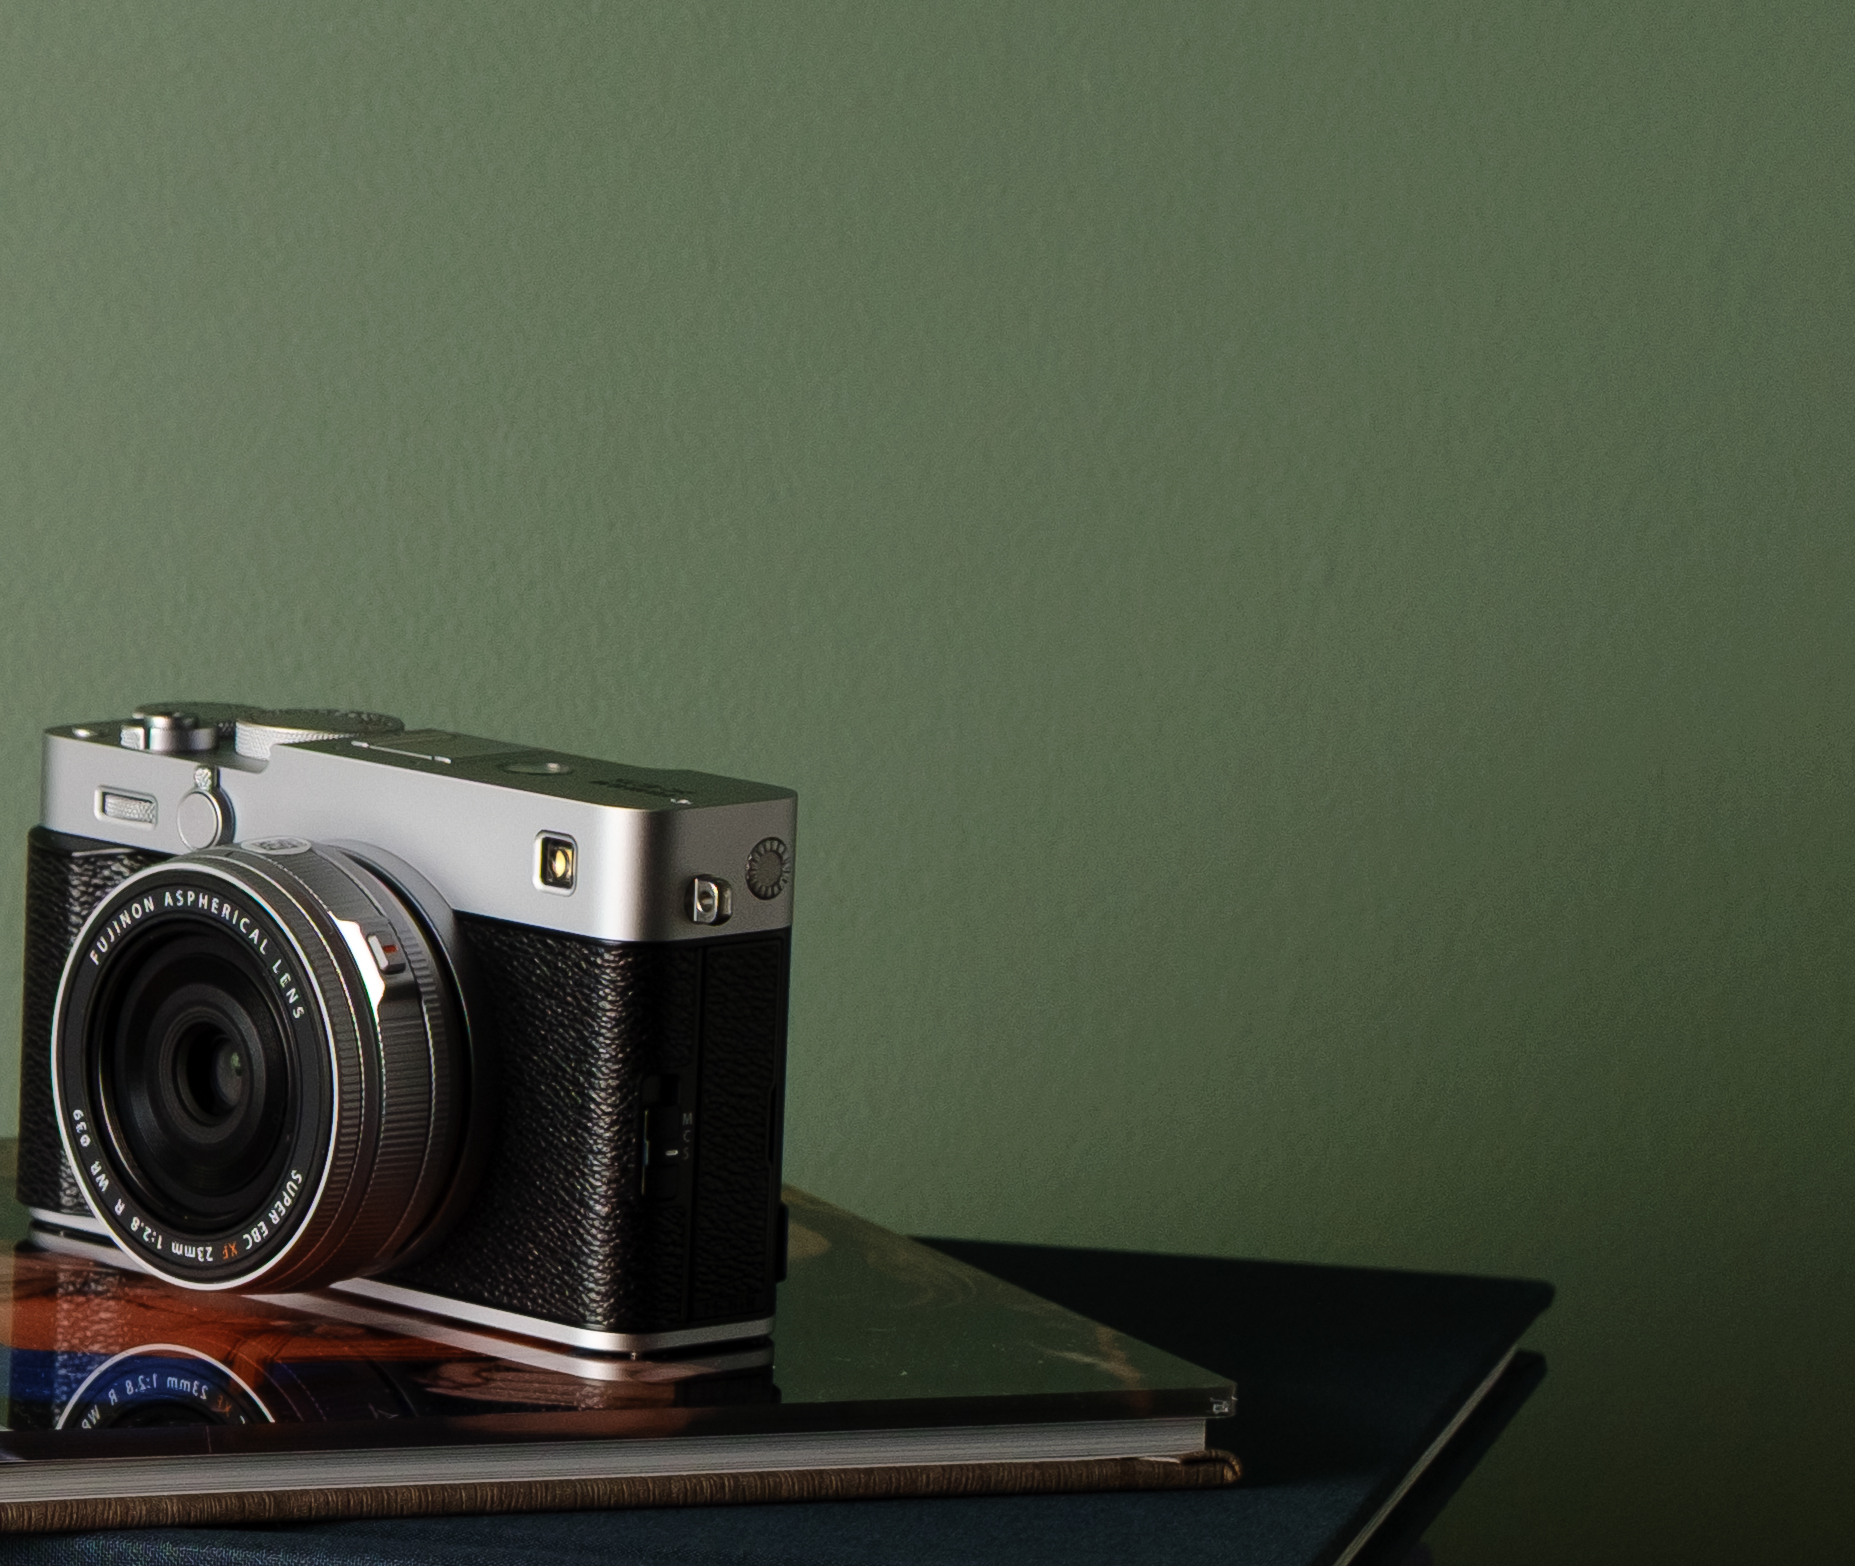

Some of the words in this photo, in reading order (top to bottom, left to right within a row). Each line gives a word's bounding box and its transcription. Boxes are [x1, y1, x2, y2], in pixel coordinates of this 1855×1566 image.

[90, 896, 154, 965] FUJINON
[164, 890, 268, 954] ASPHERICAL
[272, 959, 304, 1019] LENS
[90, 1161, 109, 1192] WR
[114, 1198, 125, 1215] R
[268, 1170, 303, 1225] SUPER
[130, 1216, 163, 1249] 1:2.8
[242, 1221, 269, 1250] EBC
[171, 1242, 213, 1261] 23mm
[222, 1242, 238, 1259] XF
